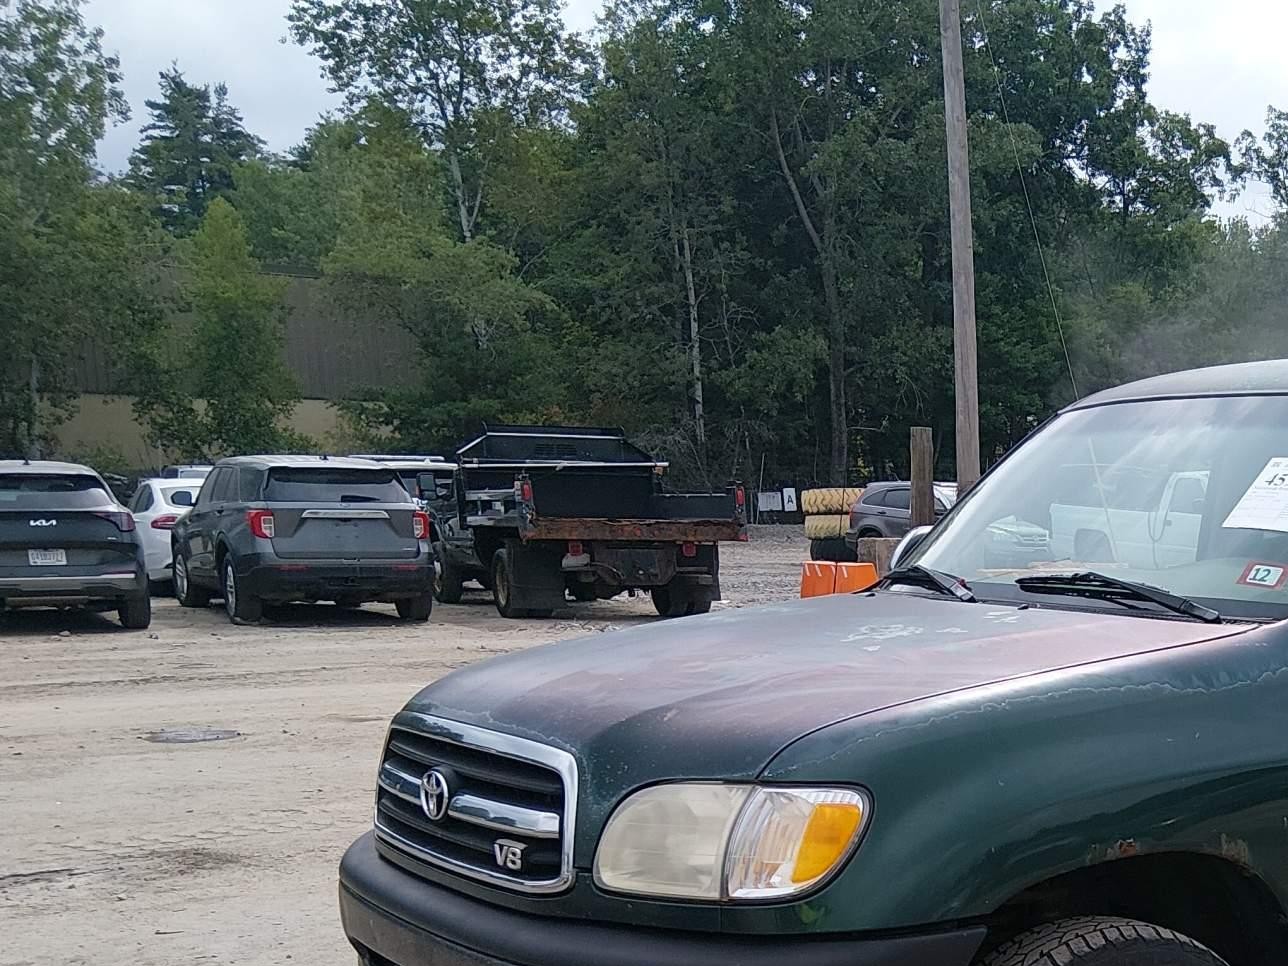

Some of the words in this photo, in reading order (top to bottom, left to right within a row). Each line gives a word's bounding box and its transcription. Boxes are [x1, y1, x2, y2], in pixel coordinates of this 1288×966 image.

[787, 494, 794, 505] A
[1249, 567, 1272, 583] 12
[494, 840, 525, 871] V8
